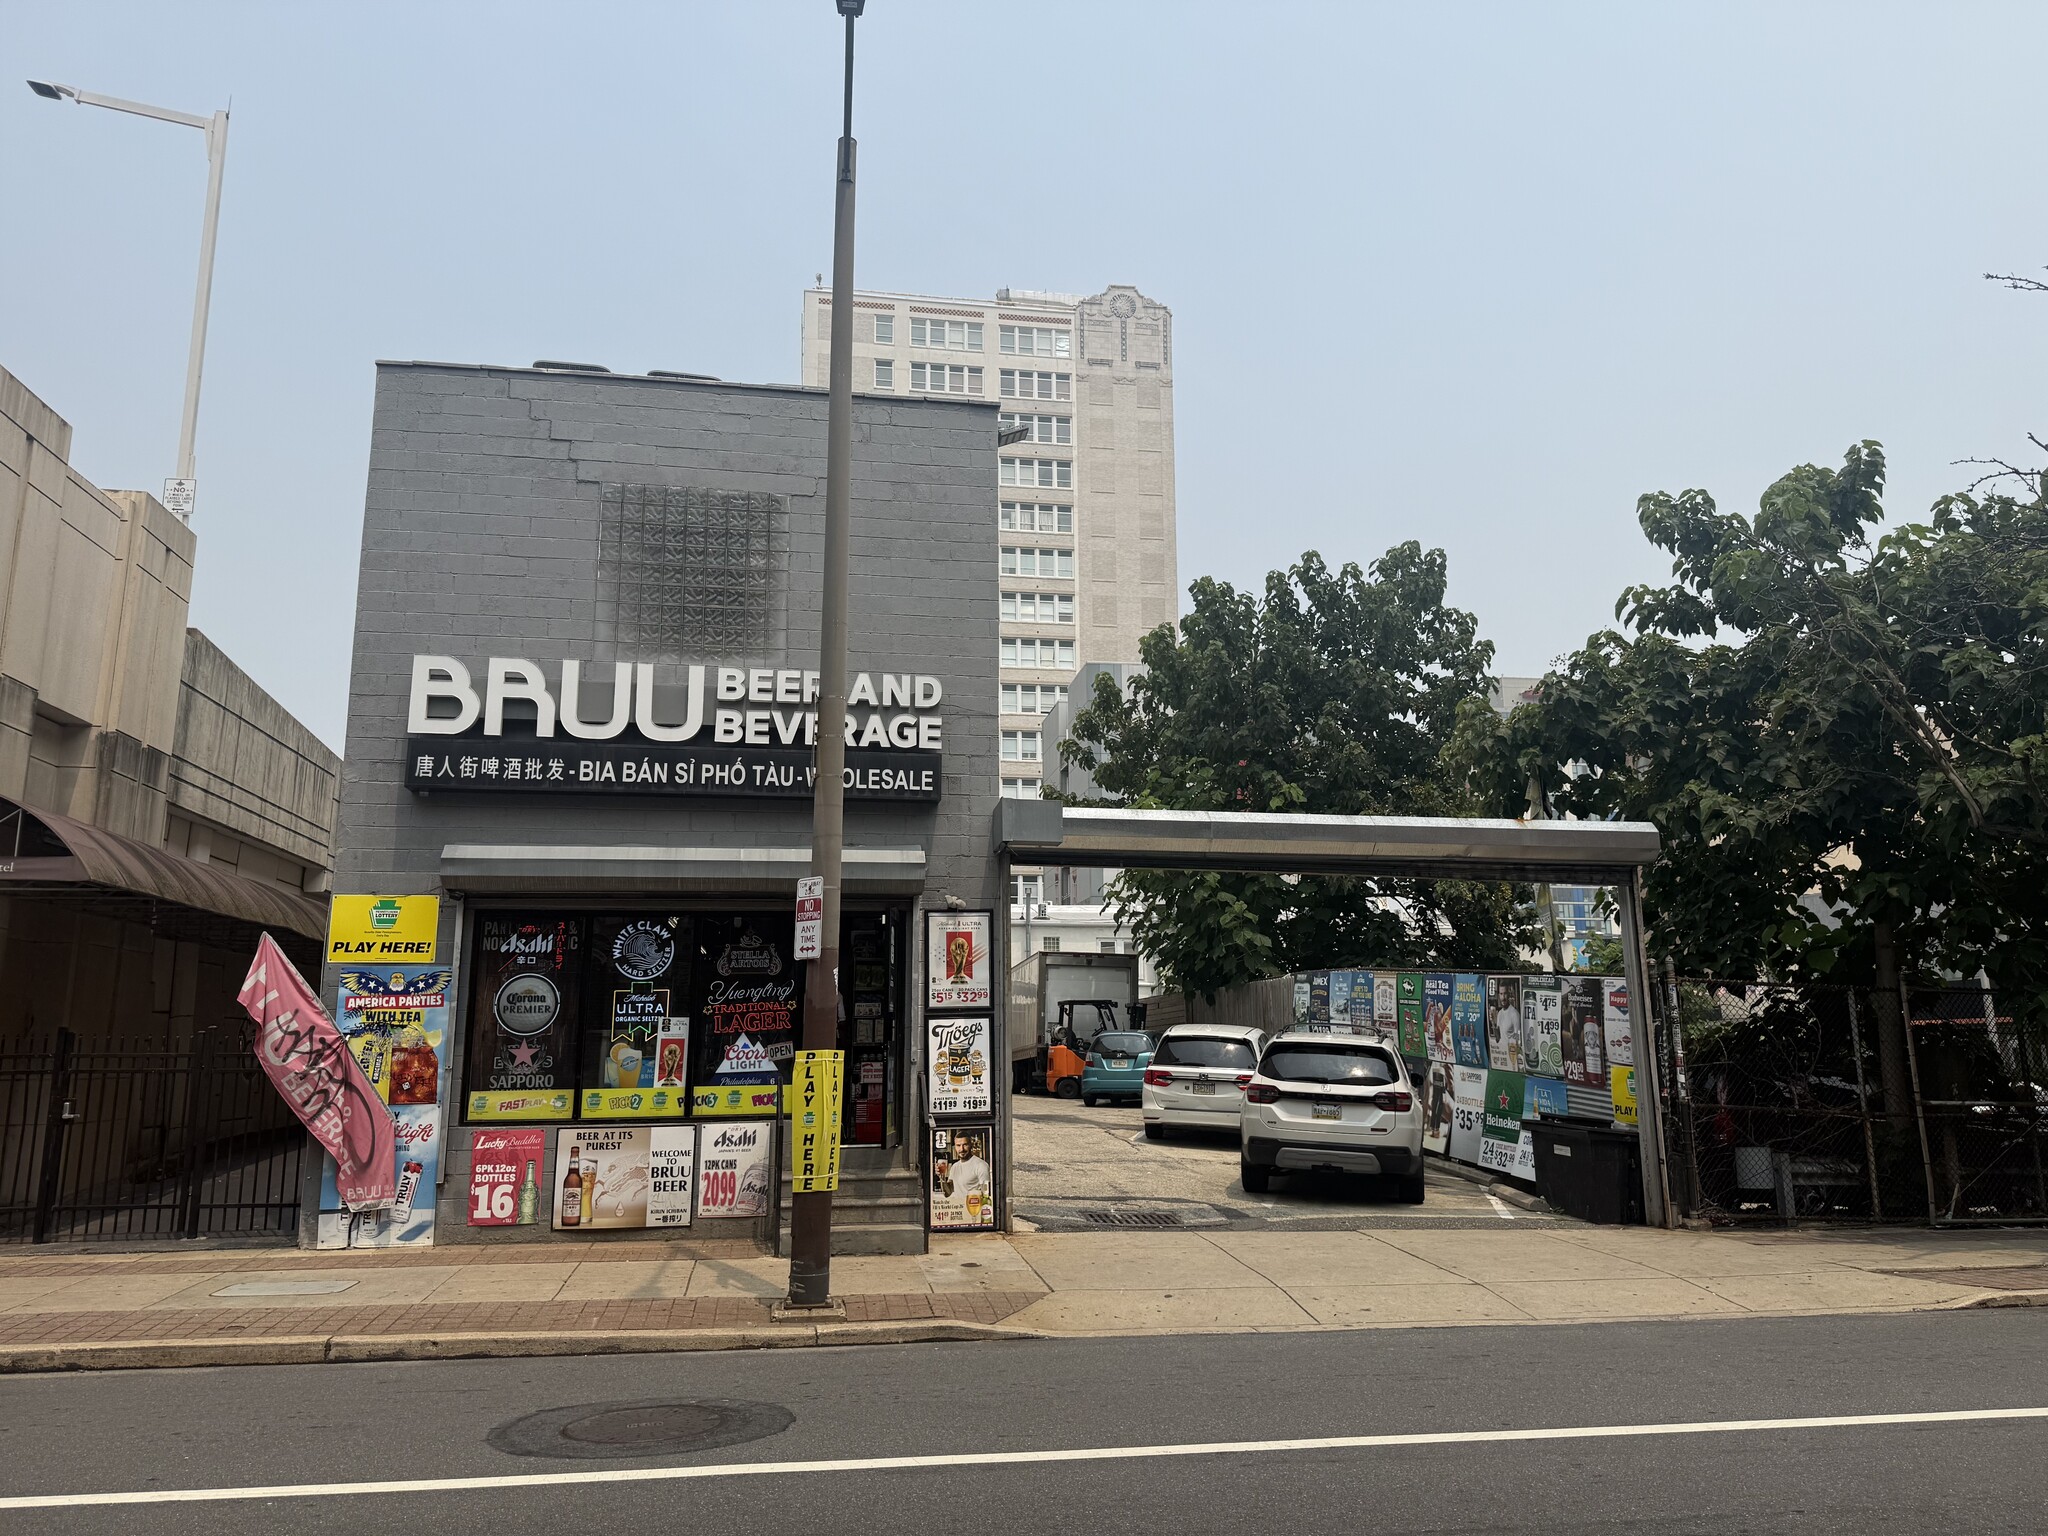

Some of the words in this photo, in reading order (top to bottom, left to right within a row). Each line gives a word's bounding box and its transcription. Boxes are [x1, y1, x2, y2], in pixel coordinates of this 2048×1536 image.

[847, 673, 943, 708] AND
[407, 654, 705, 742] BRUU
[622, 756, 668, 784] BÁN
[805, 900, 814, 911] NO
[798, 911, 820, 921] STOPPING
[801, 925, 816, 934] ANY
[500, 933, 554, 953] Asahi
[612, 924, 636, 959] WHITE
[637, 921, 671, 940] CLAW
[801, 935, 815, 943] TIME
[333, 942, 377, 953] PLAY
[380, 942, 432, 953] HERE!
[555, 921, 566, 970] スーパードライ
[516, 955, 536, 965] 辛口
[730, 950, 770, 959] STELLA
[622, 963, 644, 977] HARD
[647, 946, 671, 976] SELTZER
[730, 959, 770, 968] ARTOIS
[1425, 980, 1437, 989] Real
[1438, 980, 1449, 989] Tea
[1456, 983, 1475, 992] BRING
[708, 980, 795, 1005] Yuengling
[1460, 994, 1481, 1002] ALOHA
[1568, 993, 1593, 1003] Budweiser
[348, 997, 396, 1008] AMERICA
[399, 995, 442, 1006] PARTIES
[506, 992, 547, 1006] Corona
[1611, 995, 1627, 1004] Happy
[503, 1005, 551, 1014] PREMIER
[616, 1003, 664, 1014] ULTRA
[713, 1002, 788, 1014] TRADITIONAL
[1525, 1006, 1536, 1020] IPA
[365, 1011, 397, 1022] WITH
[400, 1011, 421, 1022] TEA
[615, 1015, 641, 1023] ORGANIC
[714, 1012, 792, 1034] LAGER
[932, 1022, 983, 1051] Tröegs
[725, 1044, 768, 1060] Coors
[769, 1045, 792, 1058] OPEN
[730, 1060, 763, 1069] LIGHT
[949, 1065, 970, 1073] LAGER
[489, 1074, 554, 1089] SAPPORO
[720, 1077, 762, 1086] Philadelphia
[804, 1052, 816, 1108] PLAY
[1466, 1072, 1482, 1080] SAPPORO
[1539, 1098, 1551, 1106] VIDA
[1615, 1105, 1633, 1117] PLAY
[1486, 1113, 1520, 1131] Heineken
[396, 1122, 434, 1144] Light
[576, 1132, 600, 1140] BEER
[603, 1132, 616, 1140] AT
[618, 1131, 633, 1139] ITS
[714, 1129, 757, 1147] Asahi
[475, 1135, 507, 1150] Lucky
[506, 1134, 541, 1147] Buddha
[586, 1142, 622, 1150] PUREST
[1483, 1140, 1495, 1156] 24
[705, 1159, 720, 1170] 12PK
[721, 1159, 737, 1170] CANS
[803, 1134, 814, 1190] HERE
[827, 1132, 836, 1189] HERE
[1481, 1155, 1493, 1164] PACK
[476, 1164, 494, 1173] 6PK
[495, 1164, 516, 1173] 12oz
[651, 1166, 691, 1178] BRUU
[475, 1173, 516, 1182] BOTTLES
[395, 1175, 411, 1206] TRULY
[653, 1180, 687, 1192] BEER
[471, 1183, 514, 1219] $16
[655, 1215, 682, 1223] 一番搾り
